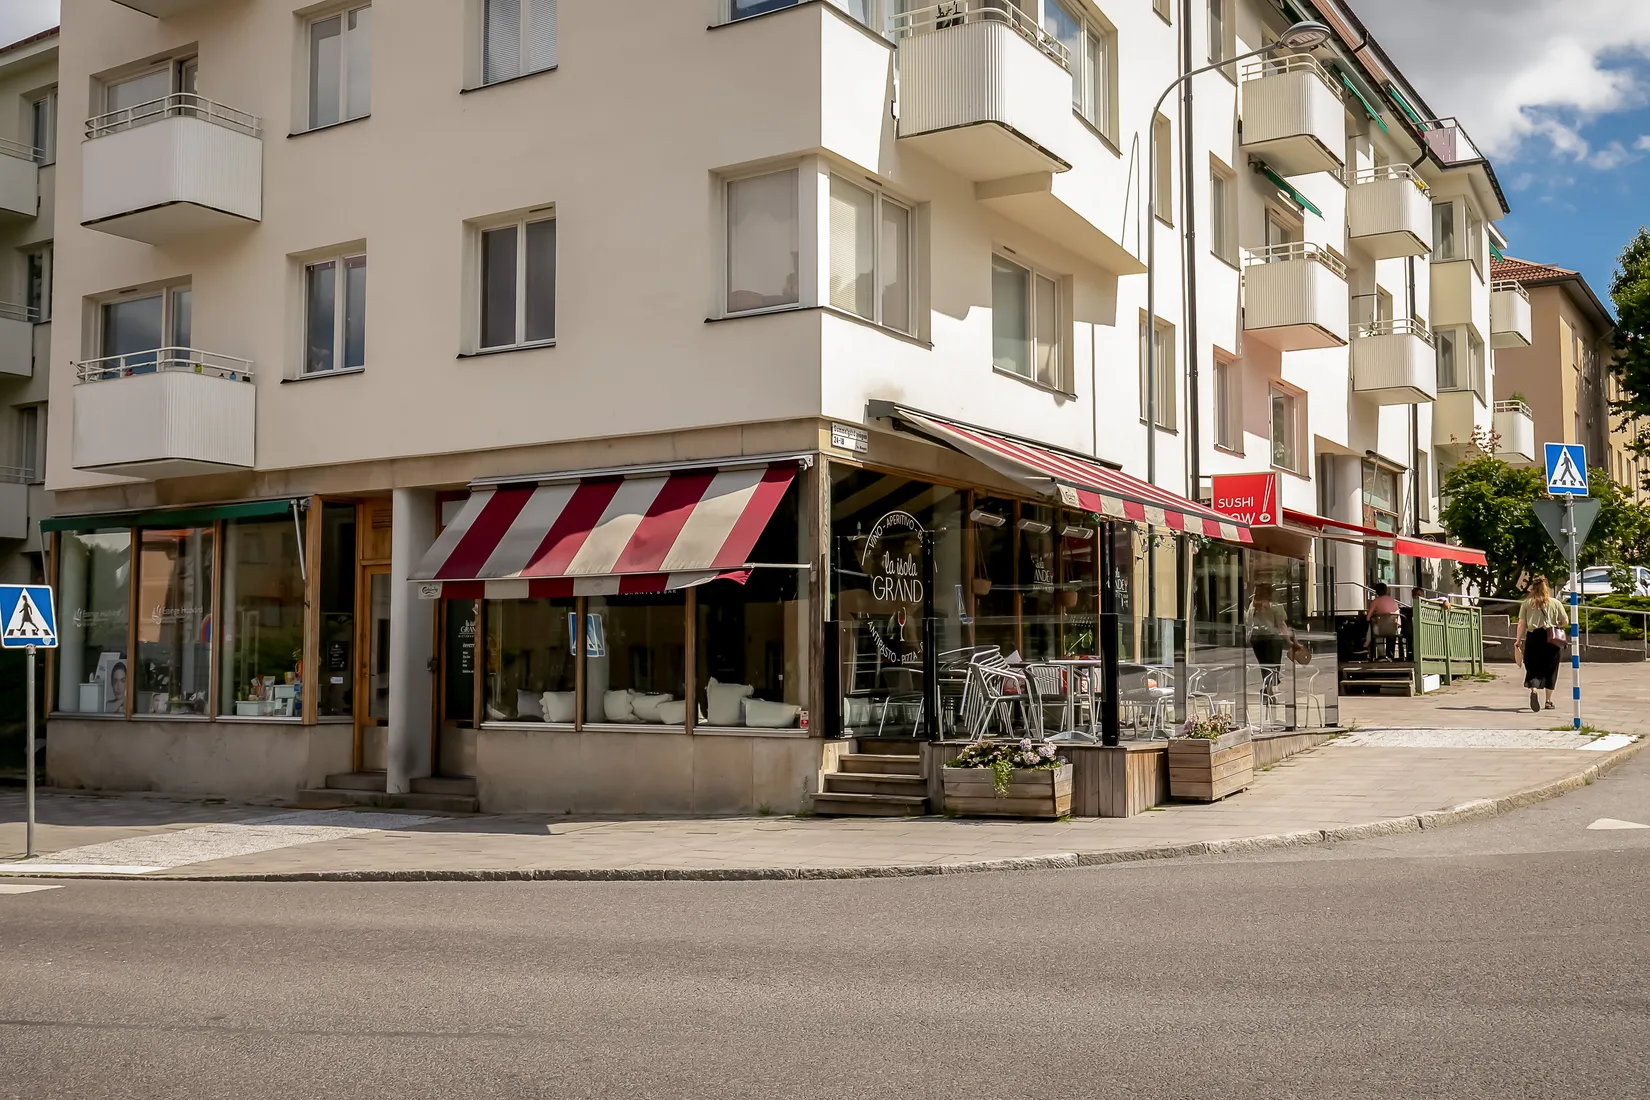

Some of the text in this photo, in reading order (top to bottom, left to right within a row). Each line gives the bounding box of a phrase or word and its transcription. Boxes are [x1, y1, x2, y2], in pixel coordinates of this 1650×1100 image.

[1217, 496, 1254, 508] SUSHI
[886, 514, 915, 530] APERITIVO
[1226, 512, 1256, 525] OW
[868, 525, 883, 548] VINO
[896, 553, 918, 577] isola
[867, 621, 897, 663] ANTIPASTO
[901, 651, 918, 665] PIZZA
